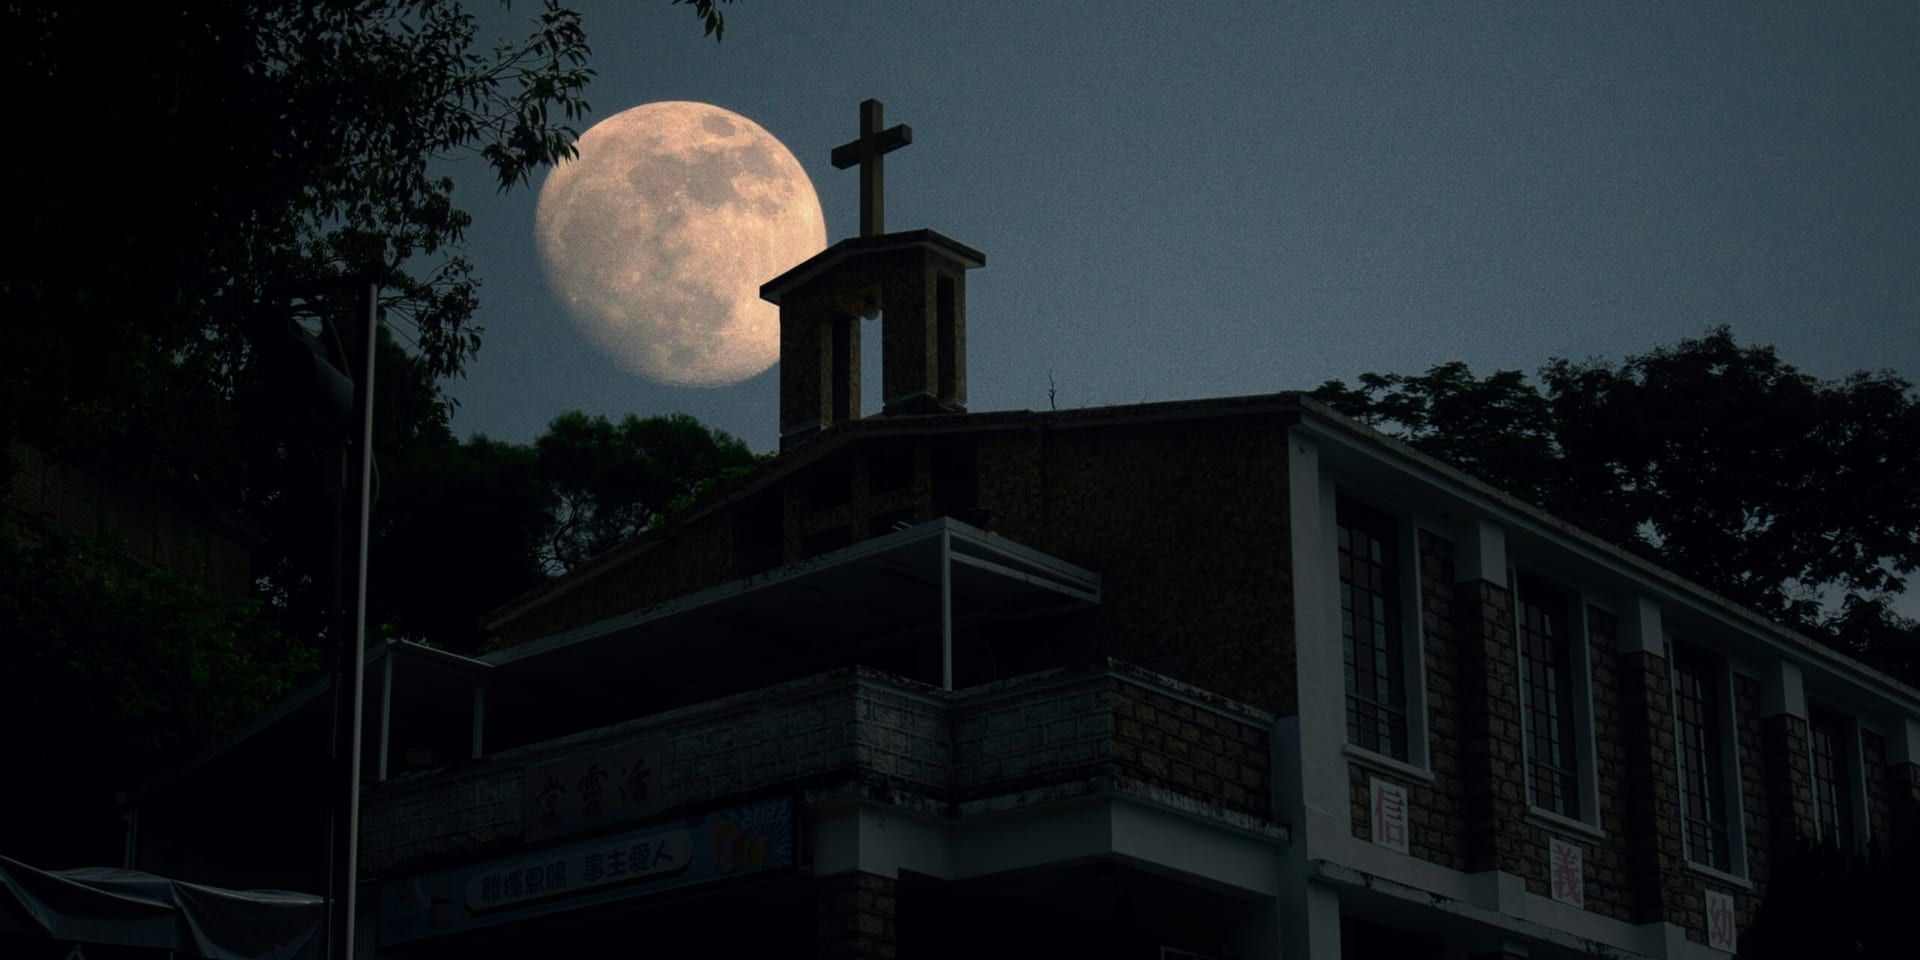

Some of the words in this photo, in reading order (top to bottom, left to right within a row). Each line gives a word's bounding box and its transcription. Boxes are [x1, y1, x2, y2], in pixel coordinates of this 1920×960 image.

[584, 840, 673, 881] 事主愛人
[1374, 786, 1405, 848] 信
[1551, 844, 1582, 903] 義
[1707, 897, 1734, 948] 幼
